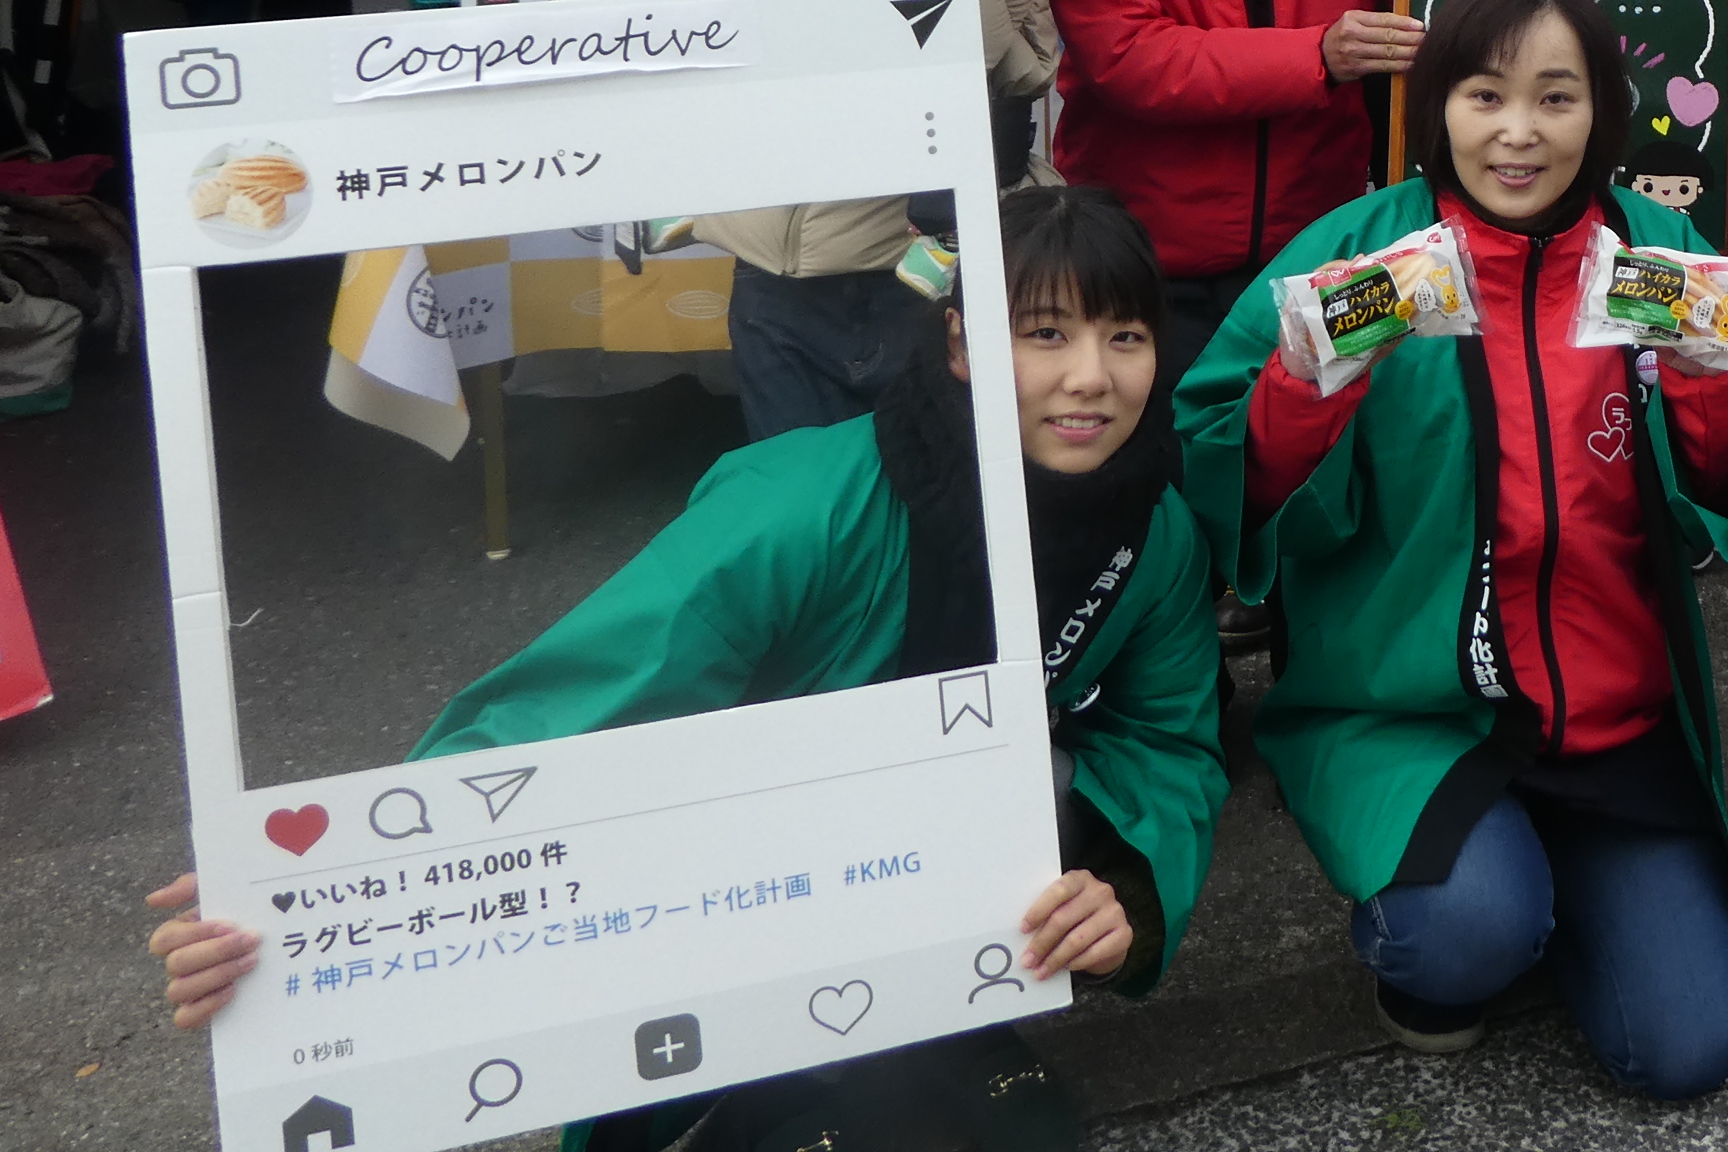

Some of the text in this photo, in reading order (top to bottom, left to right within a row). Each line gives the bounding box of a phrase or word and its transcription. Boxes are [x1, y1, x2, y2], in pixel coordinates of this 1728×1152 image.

[356, 13, 740, 83] Cooperative
[336, 149, 602, 201] 神戸メロンパン
[1350, 280, 1391, 306] ハイカラ
[1611, 281, 1679, 304] メロンパン
[1638, 268, 1682, 286] ハイカラ
[1332, 296, 1396, 337] メロンパン
[424, 848, 532, 886] 418,000
[540, 840, 568, 868] 件
[844, 851, 922, 887] #KMG
